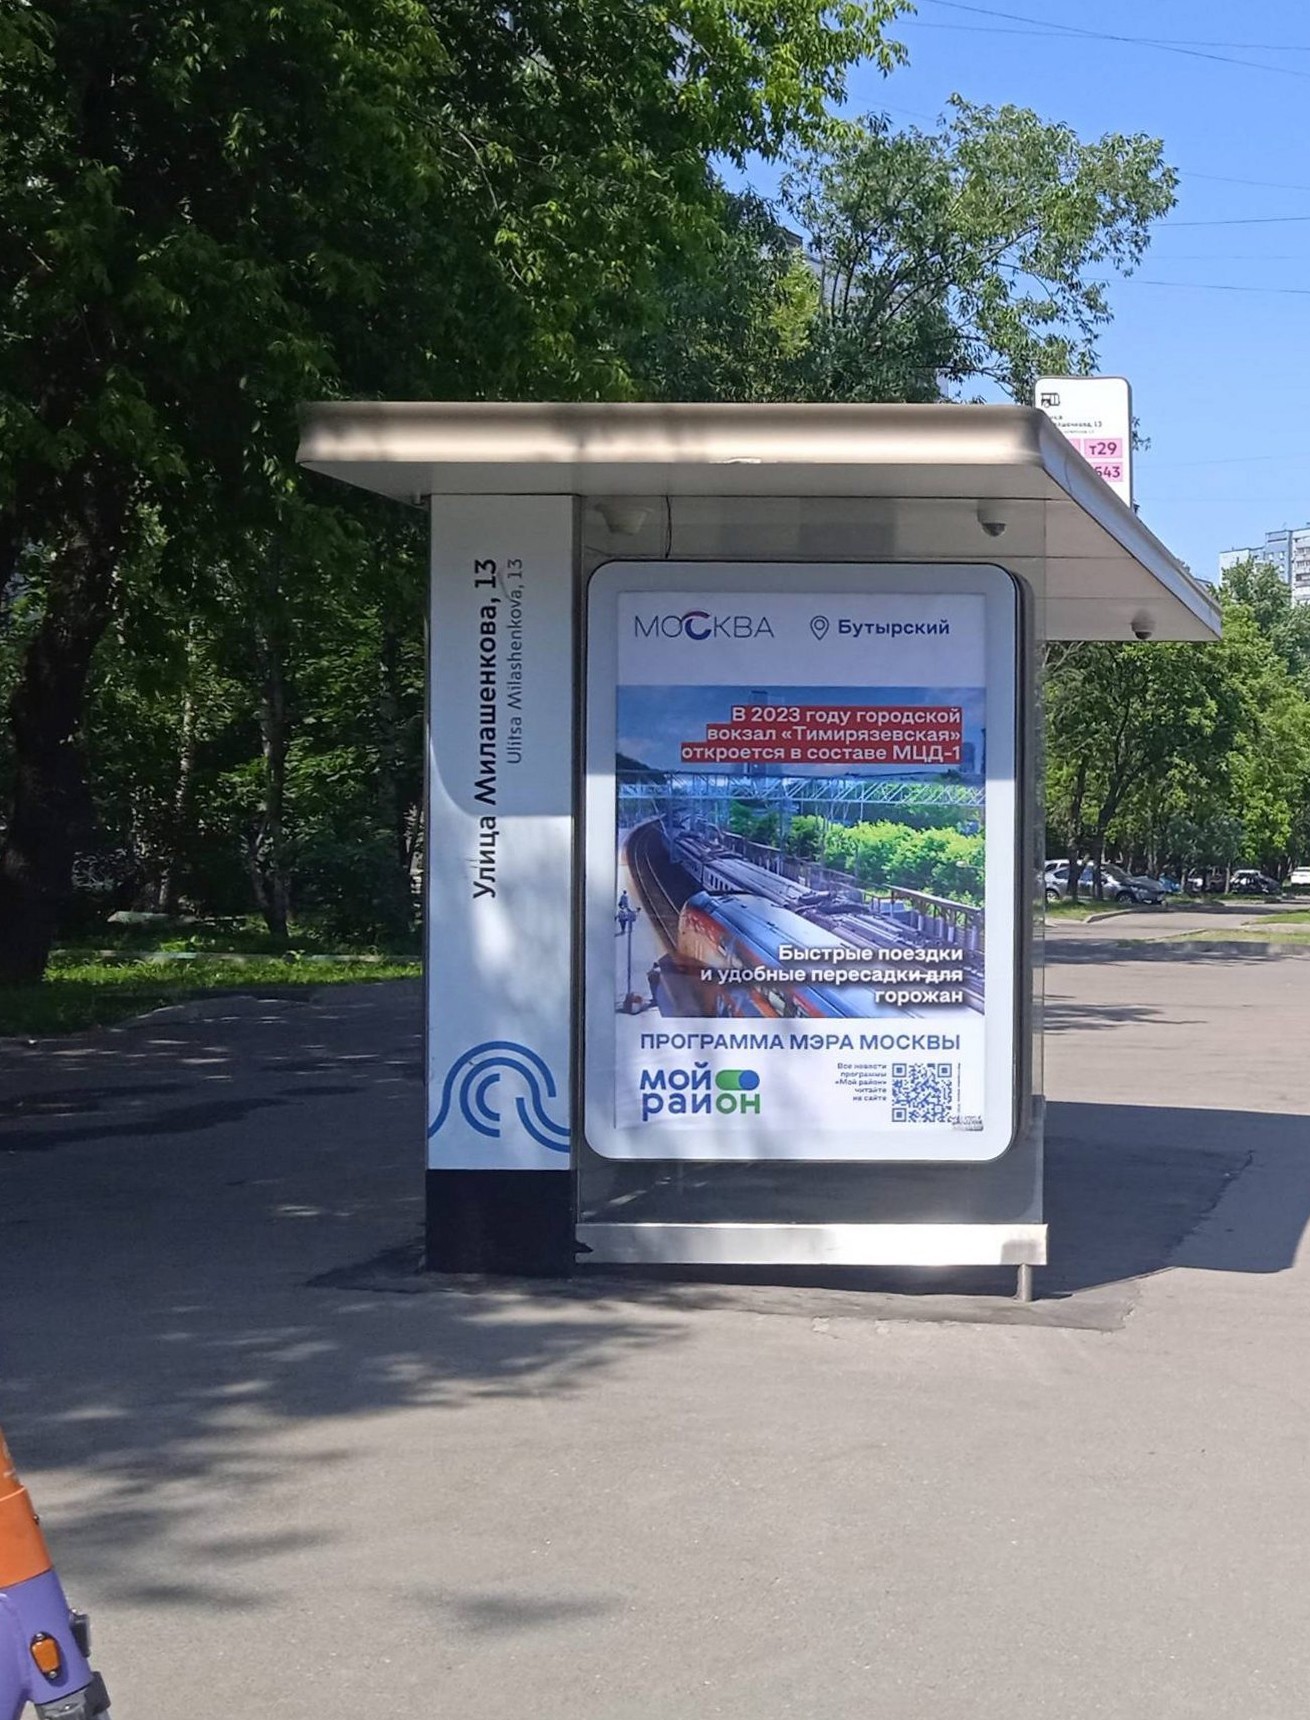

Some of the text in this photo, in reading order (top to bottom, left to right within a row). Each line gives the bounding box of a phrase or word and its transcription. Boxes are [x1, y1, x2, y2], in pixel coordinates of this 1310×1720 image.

[1089, 442, 1118, 455] т29
[634, 610, 775, 641] МОСКВА
[838, 619, 950, 638] Бутырский
[506, 559, 525, 764] Ulitsa Milashenkova, 13
[732, 707, 961, 726] В 2023 году городской
[472, 559, 501, 899] Улица Милашенкова, 13
[707, 726, 961, 744] вокзал «Тимирязевская»
[682, 745, 961, 763] откроется в составе МЦД-1
[778, 944, 963, 964] Быстрые поездки
[700, 968, 713, 981] и
[718, 965, 806, 985] удобные
[926, 969, 963, 984] для
[874, 990, 963, 1005] горожан
[640, 1033, 961, 1050] ПРОГРАММА МЭРА МОСКВЫ
[639, 1061, 712, 1091] мой
